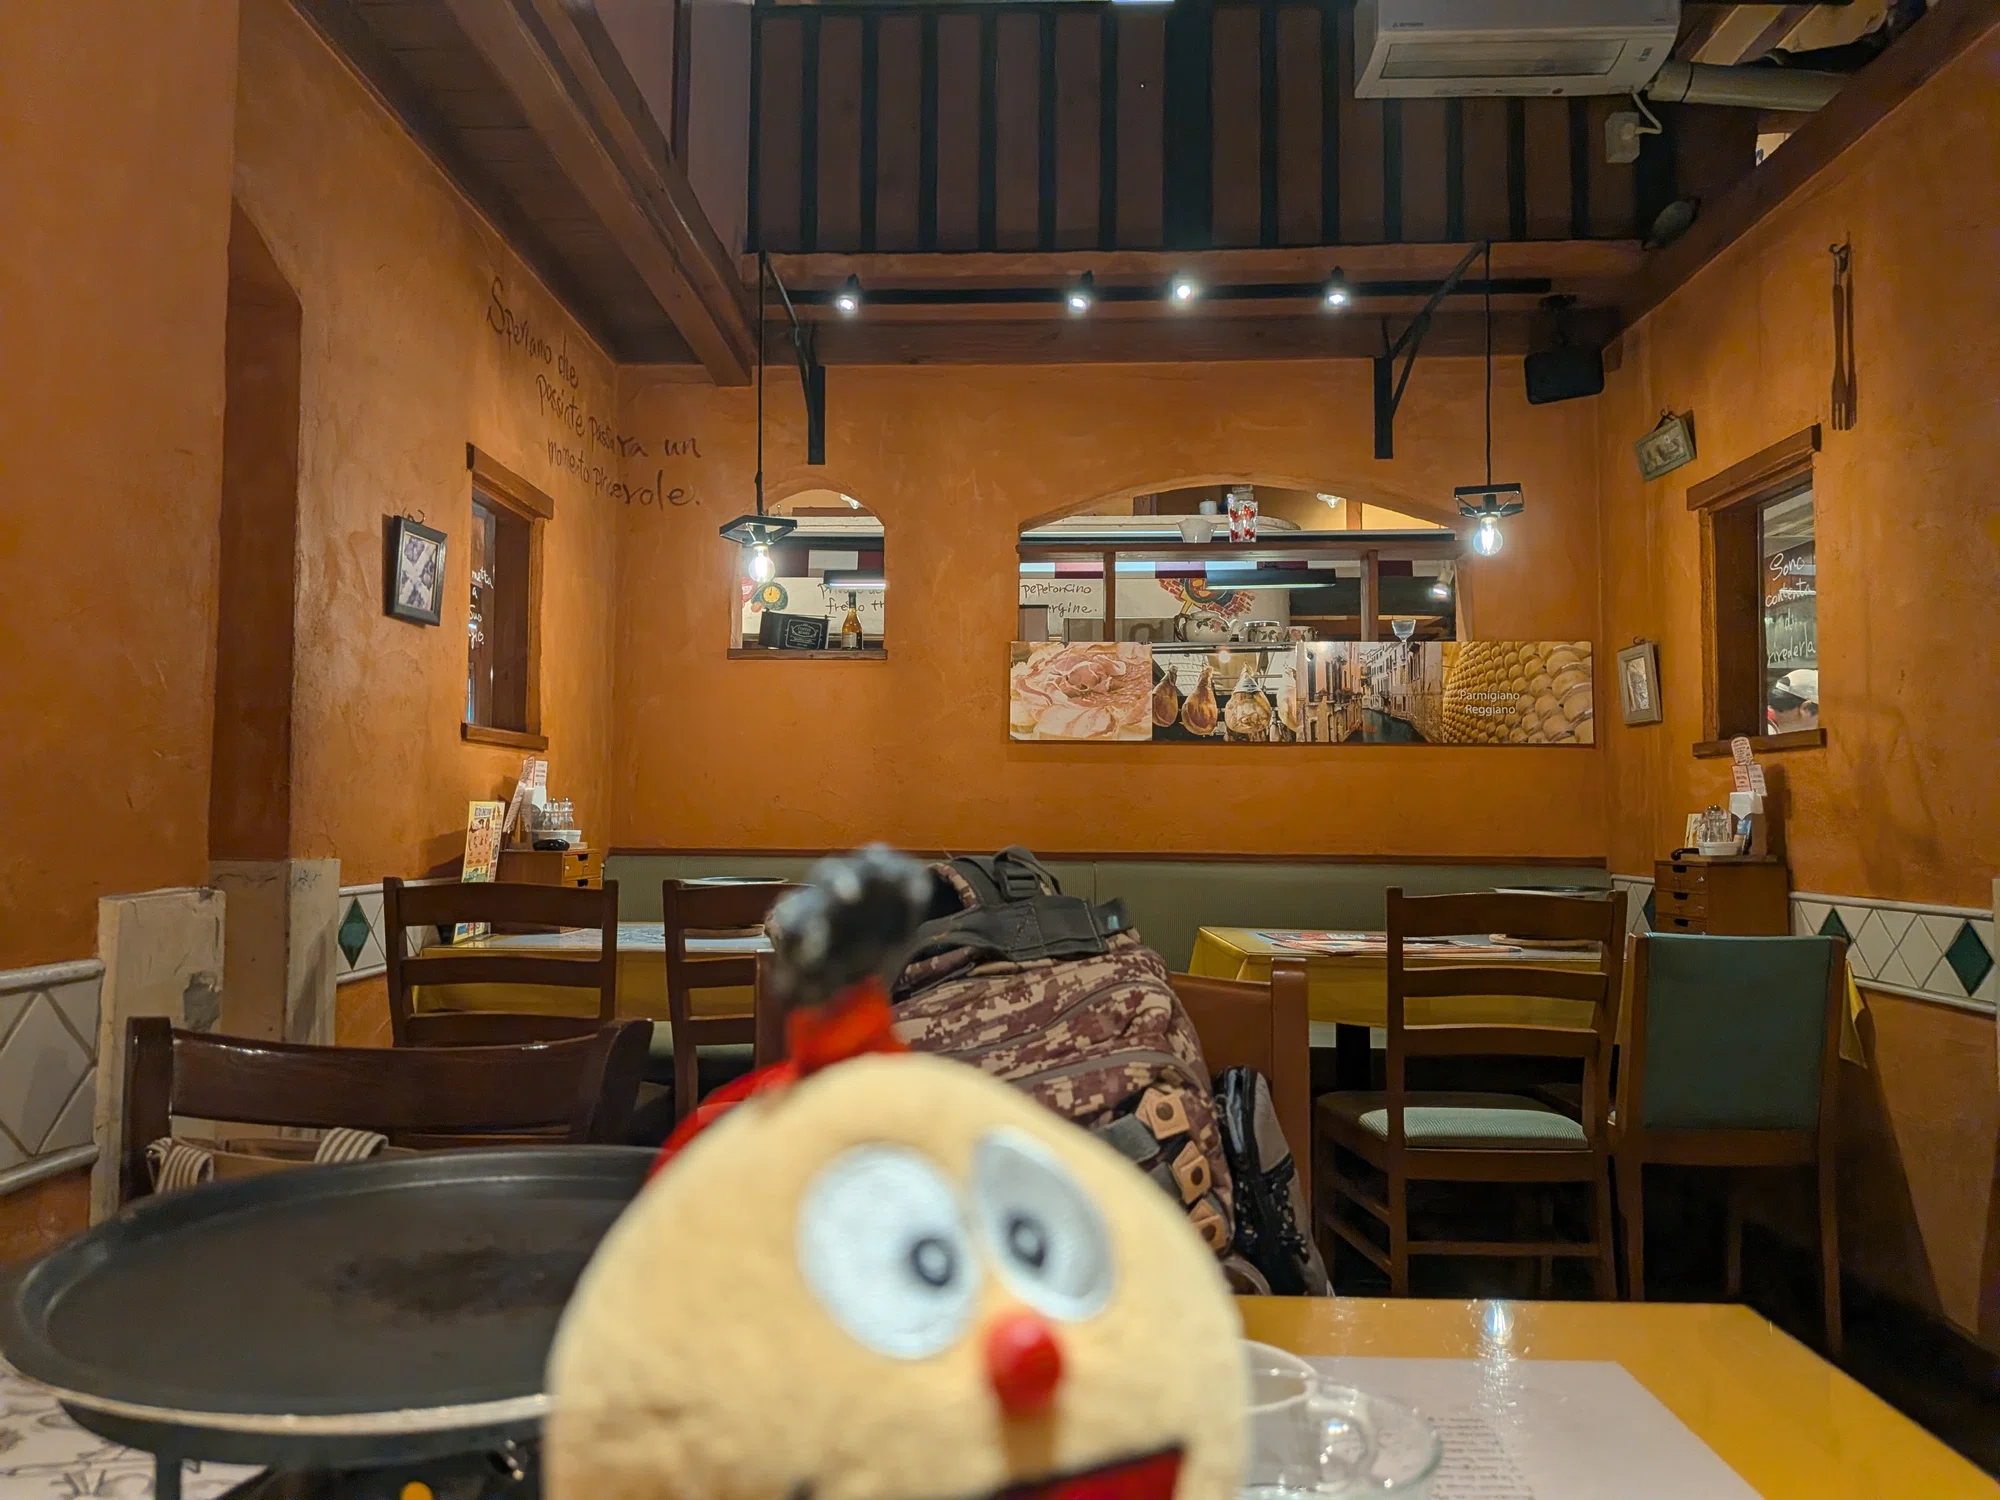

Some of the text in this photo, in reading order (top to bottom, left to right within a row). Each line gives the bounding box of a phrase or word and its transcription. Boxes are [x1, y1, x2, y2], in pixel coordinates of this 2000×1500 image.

[665, 437, 702, 459] un
[1460, 690, 1520, 702] Parmigiano
[1465, 704, 1516, 717] Reggiano
